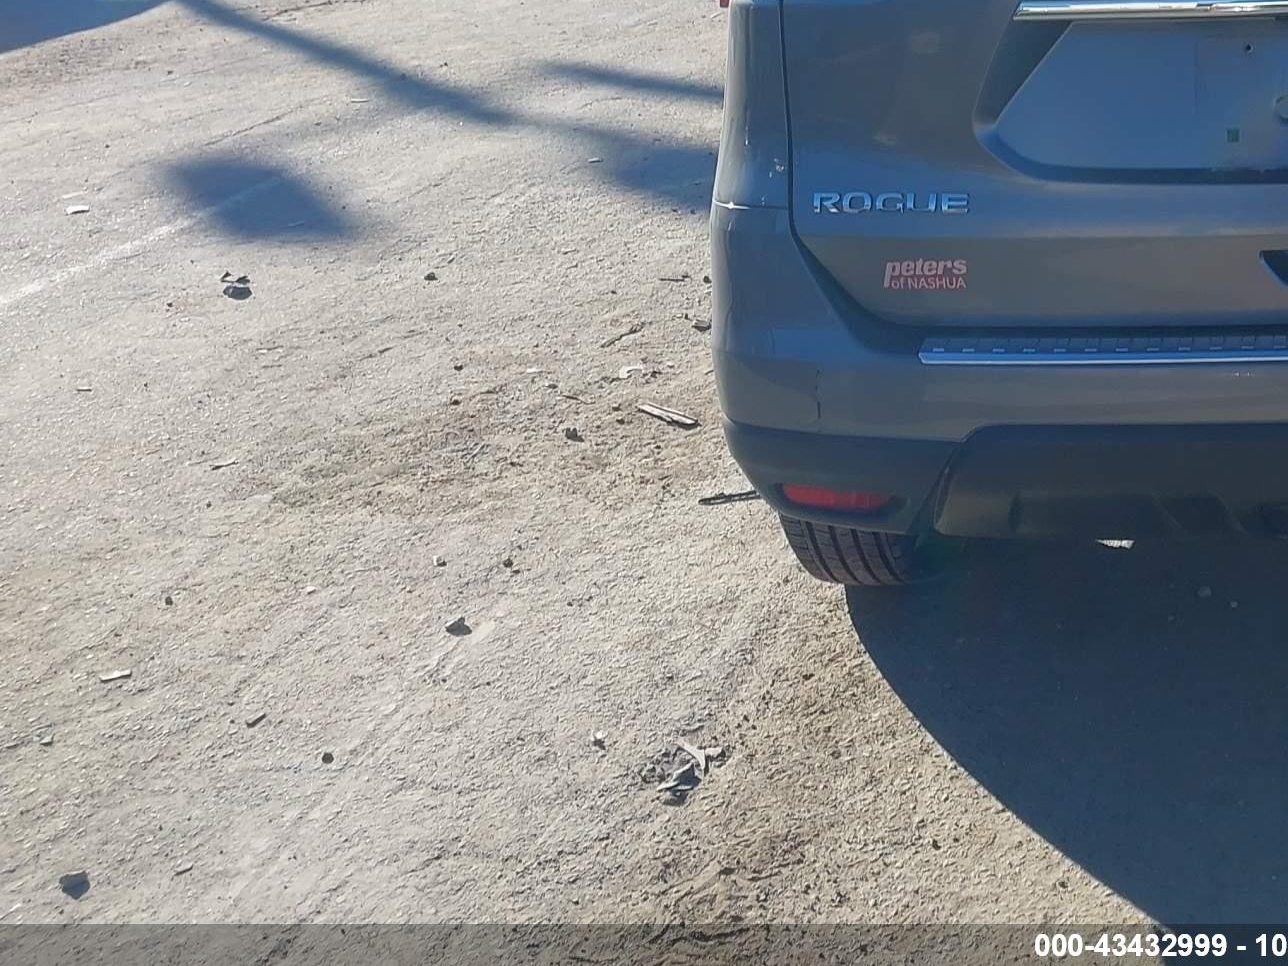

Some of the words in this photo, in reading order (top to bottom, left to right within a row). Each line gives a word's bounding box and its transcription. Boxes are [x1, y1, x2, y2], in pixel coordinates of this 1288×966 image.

[812, 191, 970, 214] ROGUE
[883, 257, 968, 288] peters
[891, 276, 906, 290] of
[907, 276, 967, 290] NASHUA
